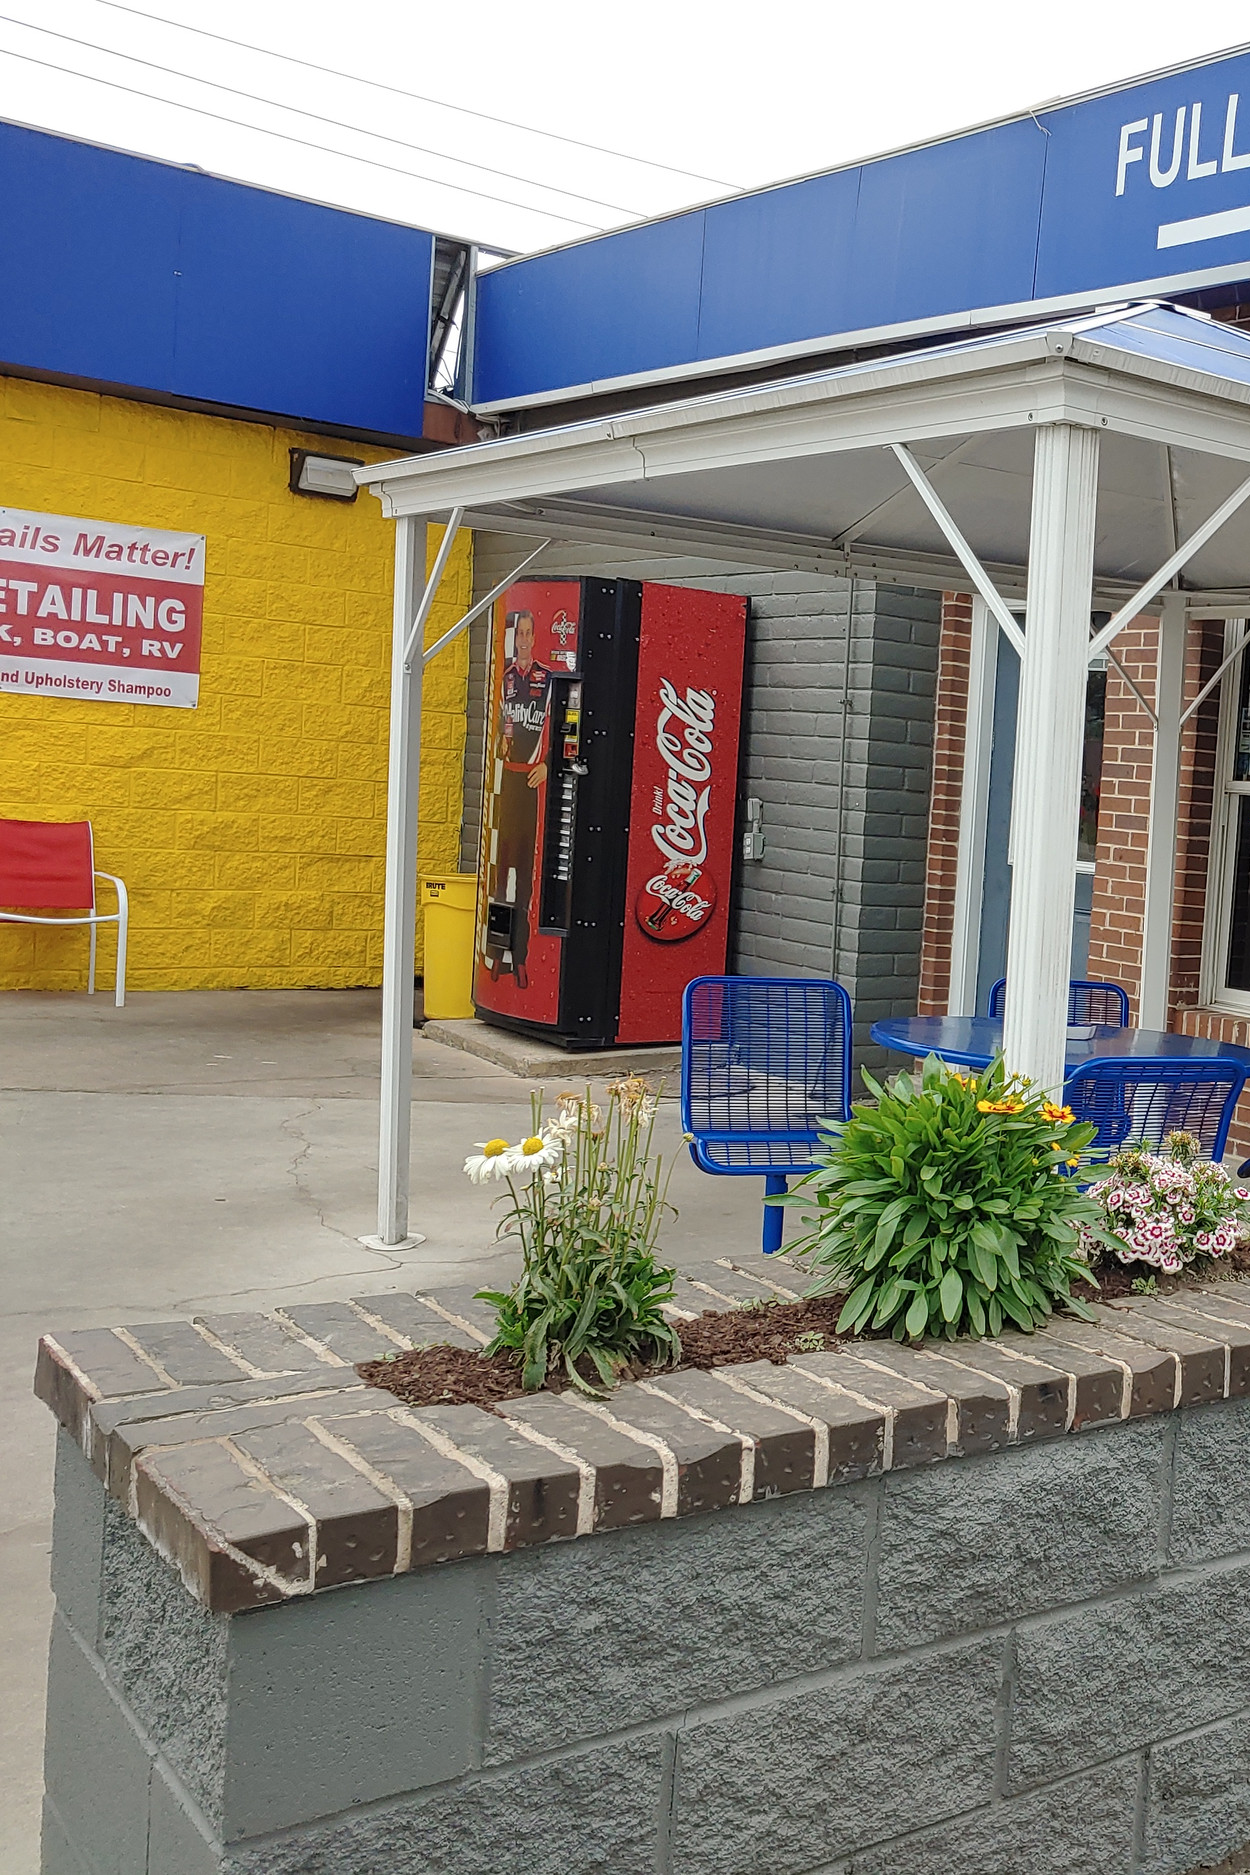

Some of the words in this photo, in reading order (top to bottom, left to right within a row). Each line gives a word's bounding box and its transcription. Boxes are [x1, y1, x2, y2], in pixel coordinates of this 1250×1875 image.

[72, 533, 196, 570] Matter!
[33, 628, 131, 657] BOAT,
[141, 639, 184, 659] RV
[1, 670, 19, 683] nd
[25, 671, 103, 693] Upholstery
[108, 679, 171, 697] Shampoo
[652, 676, 717, 865] Coca-Cola
[425, 882, 446, 890] BRUTE
[645, 873, 711, 922] Coca-Cola
